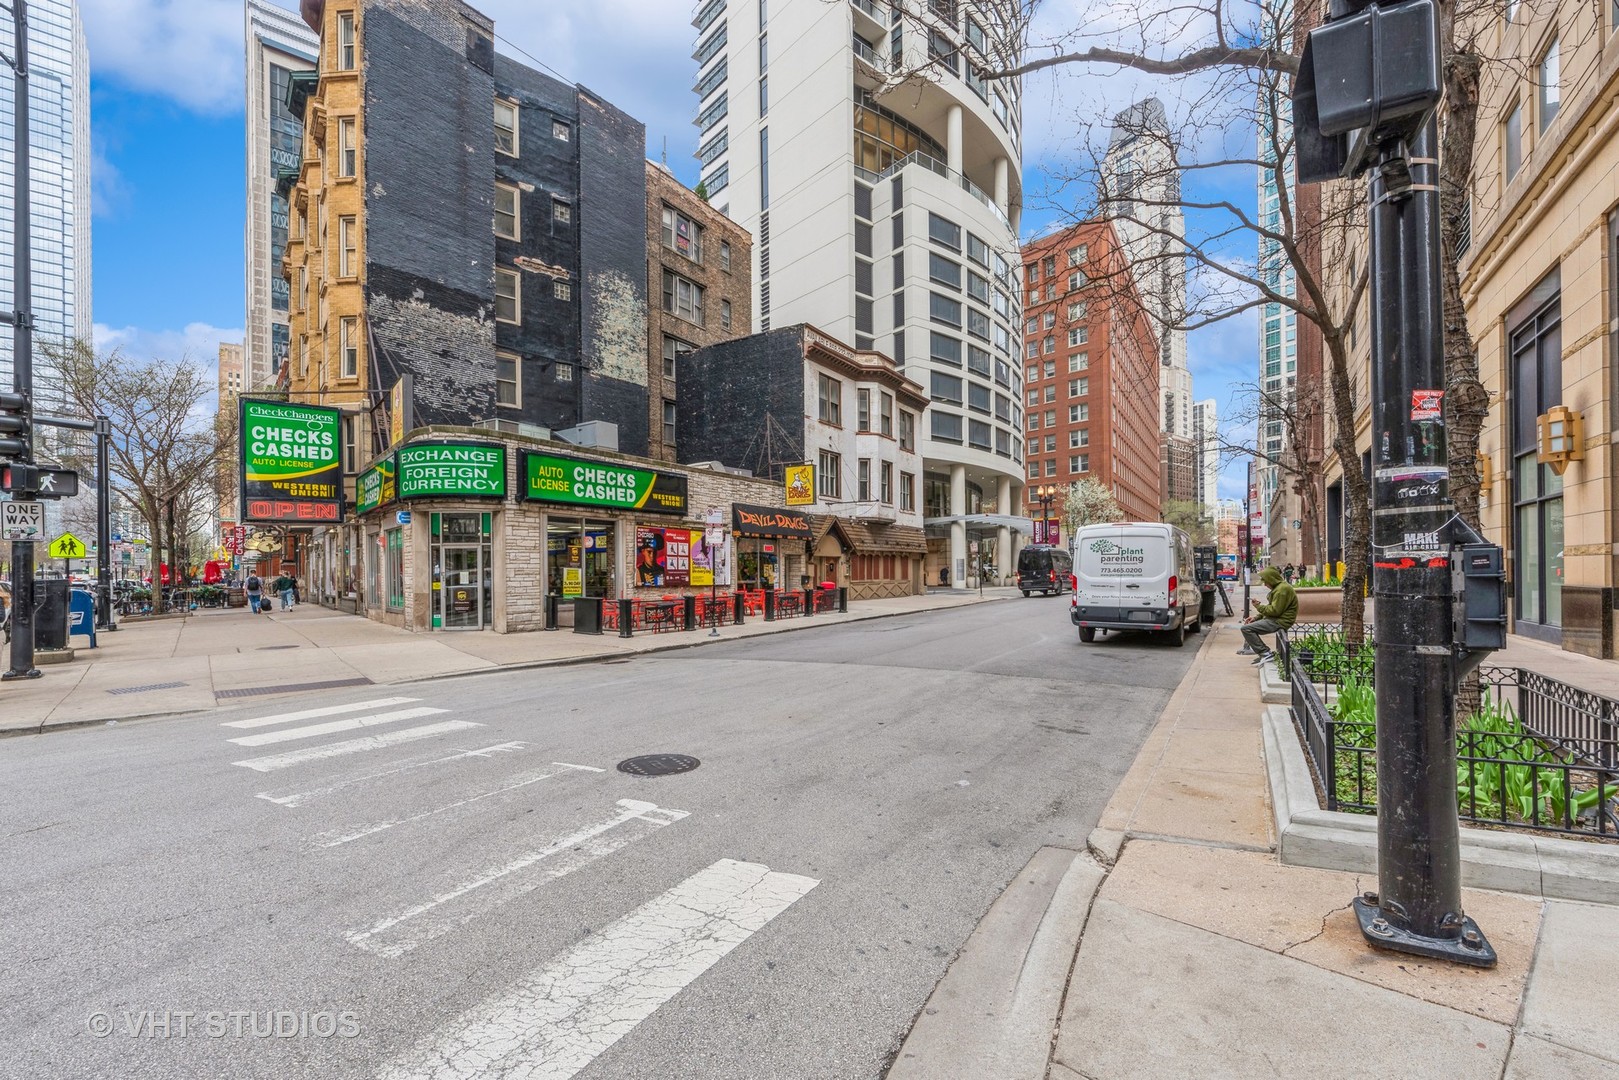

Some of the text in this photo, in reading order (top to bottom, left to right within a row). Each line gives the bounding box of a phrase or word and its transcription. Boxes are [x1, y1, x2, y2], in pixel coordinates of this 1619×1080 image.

[249, 406, 334, 422] CheckChangers
[251, 425, 333, 445] CHECKS
[251, 442, 333, 460] CASHED
[401, 450, 498, 463] EXCHANGE
[252, 458, 314, 468] AUTO LICENSE
[406, 467, 488, 479] FOREIGN
[538, 465, 564, 479] AUTO
[573, 466, 636, 488] CHECKS
[272, 482, 328, 491] WESTERN
[402, 479, 500, 492] CURRENCY
[531, 477, 570, 492] LICENSE
[290, 489, 328, 497] UNION
[573, 483, 637, 503] CASHED
[652, 493, 680, 502] WESTERN
[7, 504, 39, 514] ONE
[250, 501, 336, 519] OPEN
[6, 515, 39, 525] WAY
[451, 519, 475, 533] ATM
[737, 509, 776, 527] DEVIL
[775, 514, 809, 530] DAWGS
[1404, 532, 1439, 544] MAKE
[1121, 547, 1144, 556] plant
[1100, 555, 1144, 564] parenting
